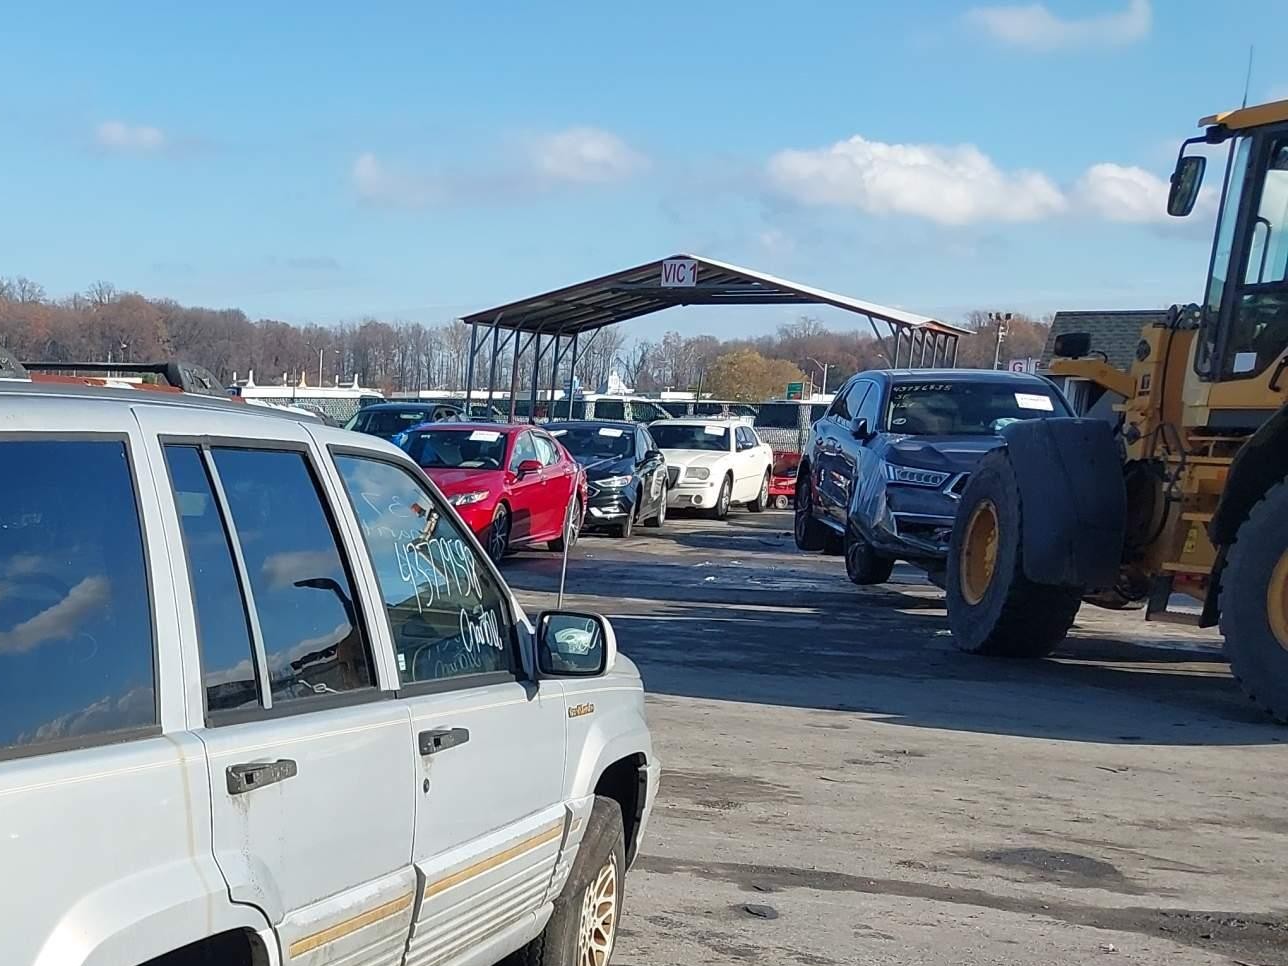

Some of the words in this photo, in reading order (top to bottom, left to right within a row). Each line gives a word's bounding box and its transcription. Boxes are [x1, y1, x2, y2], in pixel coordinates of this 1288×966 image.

[663, 263, 687, 283] VIC
[689, 263, 697, 283] 1
[1012, 361, 1023, 373] G
[394, 537, 484, 615] 43779598
